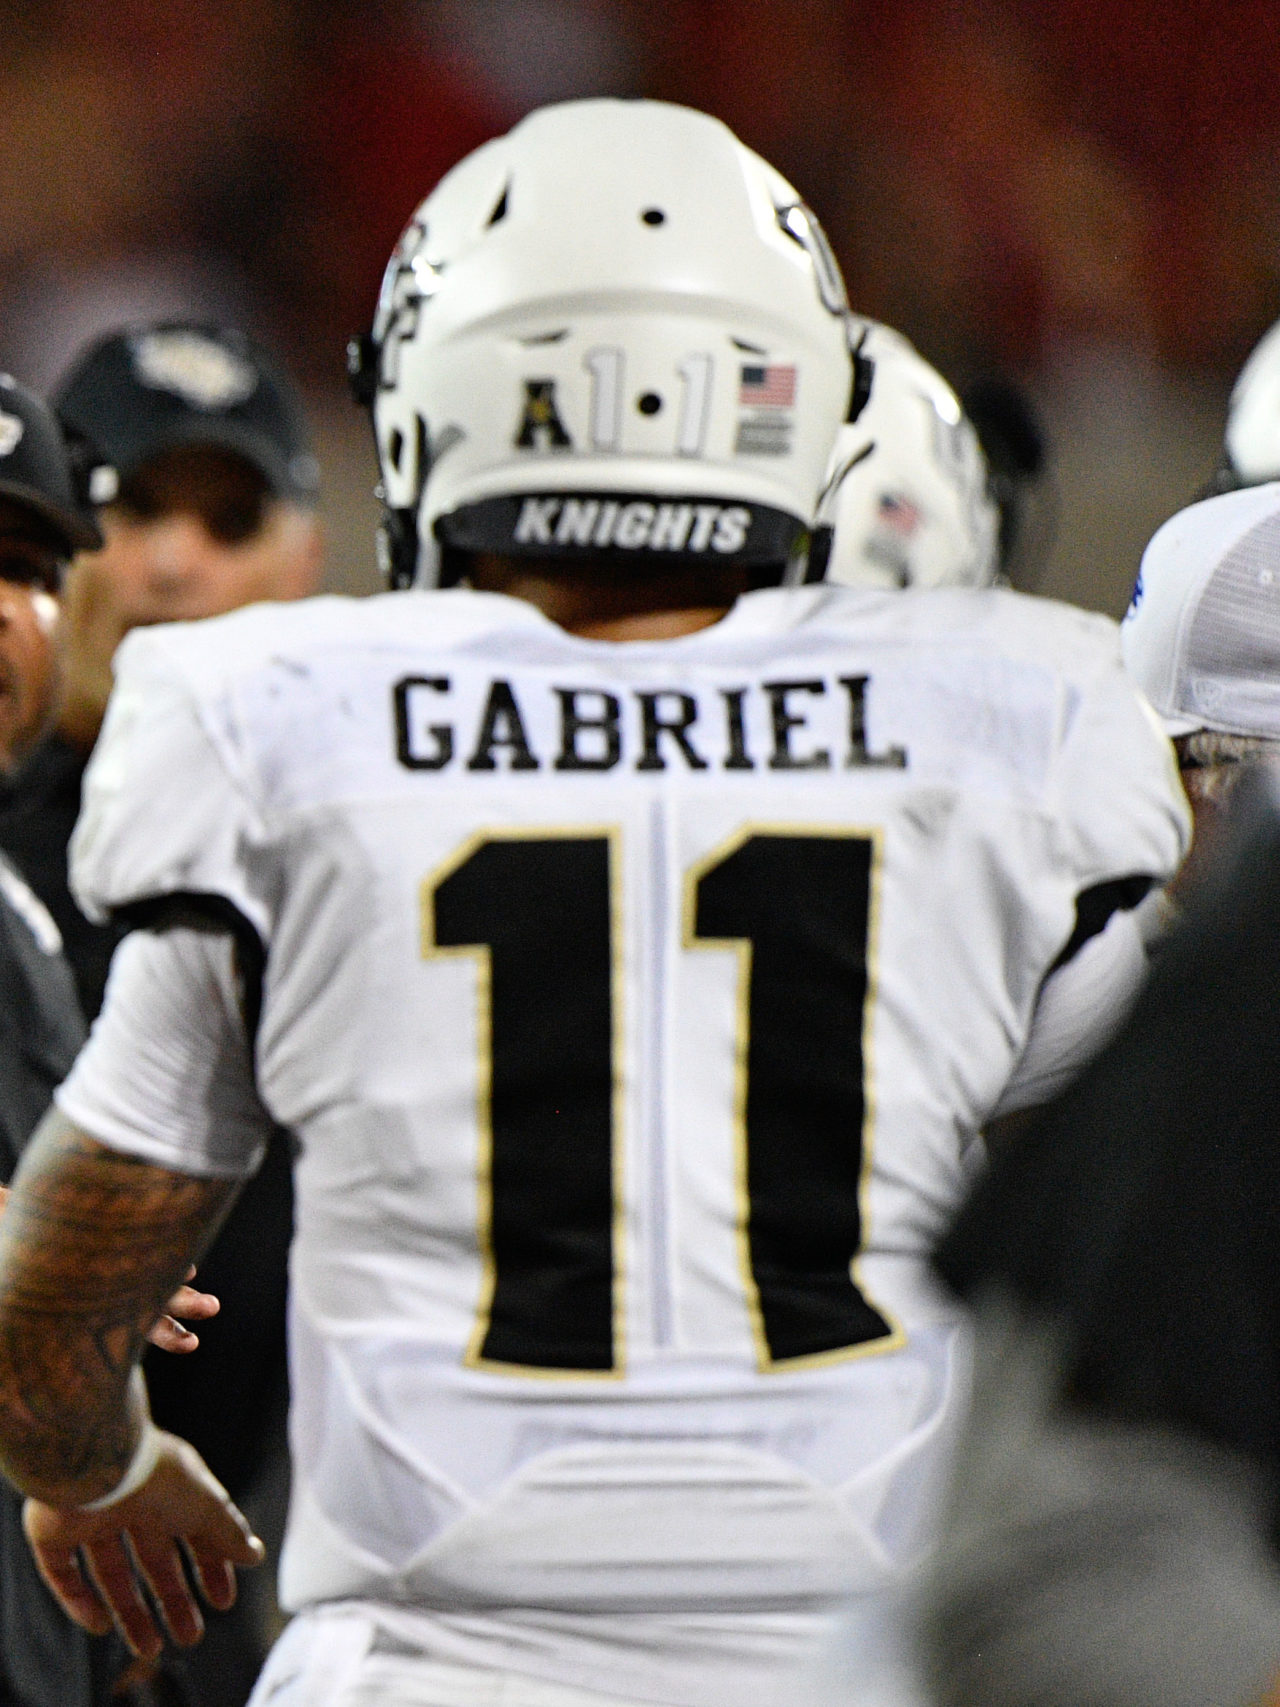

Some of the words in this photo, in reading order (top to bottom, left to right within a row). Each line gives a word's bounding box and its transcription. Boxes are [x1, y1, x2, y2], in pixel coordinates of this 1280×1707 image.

[513, 497, 753, 554] KNIGHTS
[391, 674, 908, 773] GABRIEL
[419, 820, 908, 1381] 11
